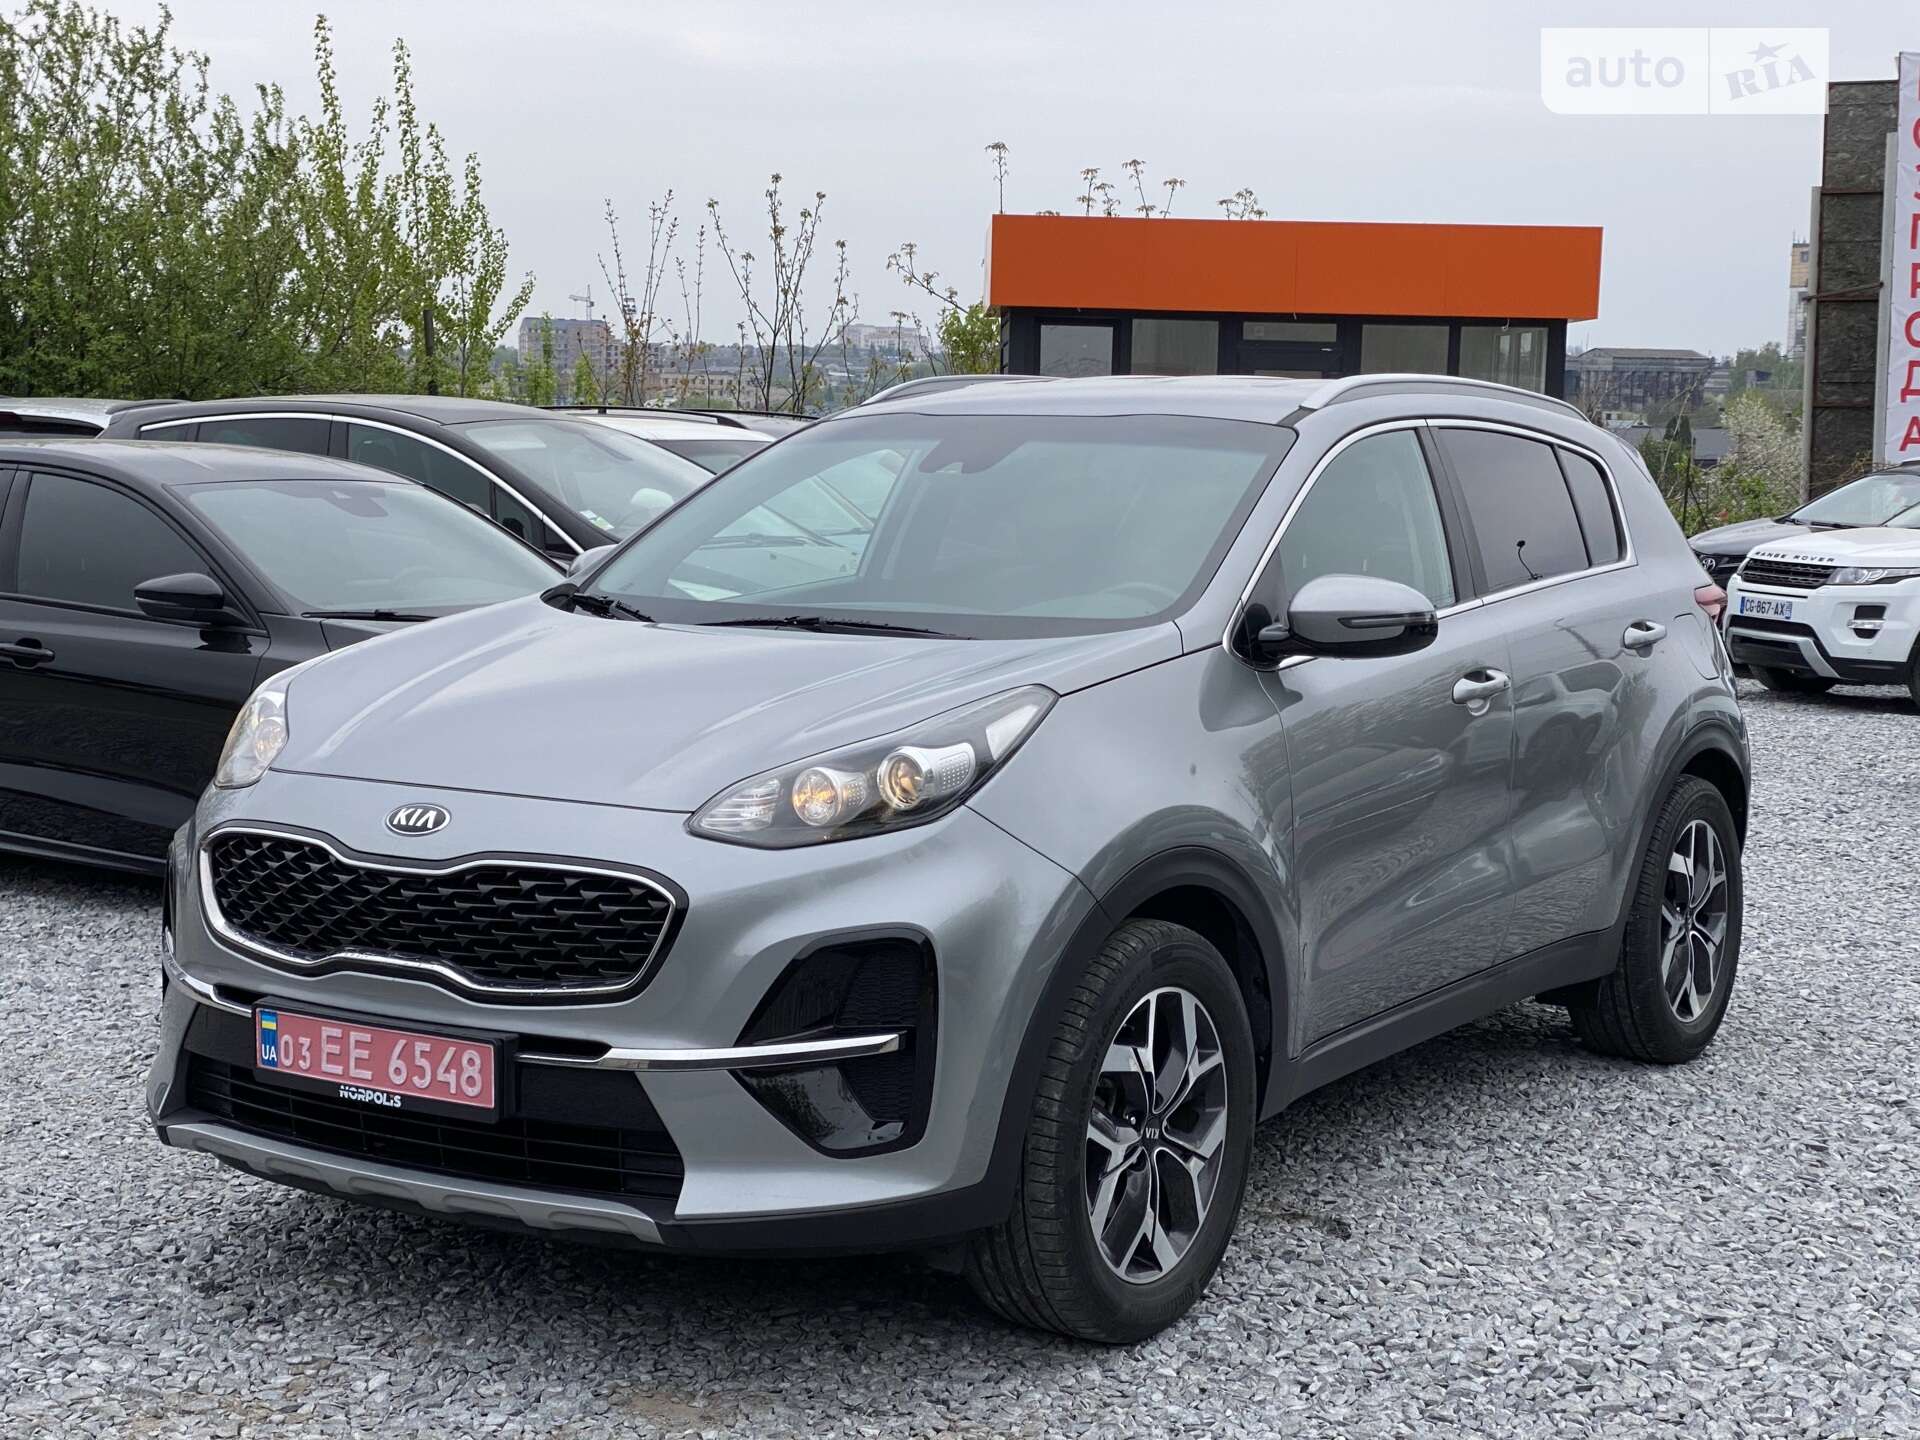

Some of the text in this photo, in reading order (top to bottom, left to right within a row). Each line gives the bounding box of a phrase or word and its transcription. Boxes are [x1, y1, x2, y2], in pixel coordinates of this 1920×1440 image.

[1754, 551, 1835, 563] RANGE ROVER
[392, 807, 437, 829] KIA
[261, 1045, 278, 1063] UA
[280, 1026, 483, 1097] 03 EE 6548
